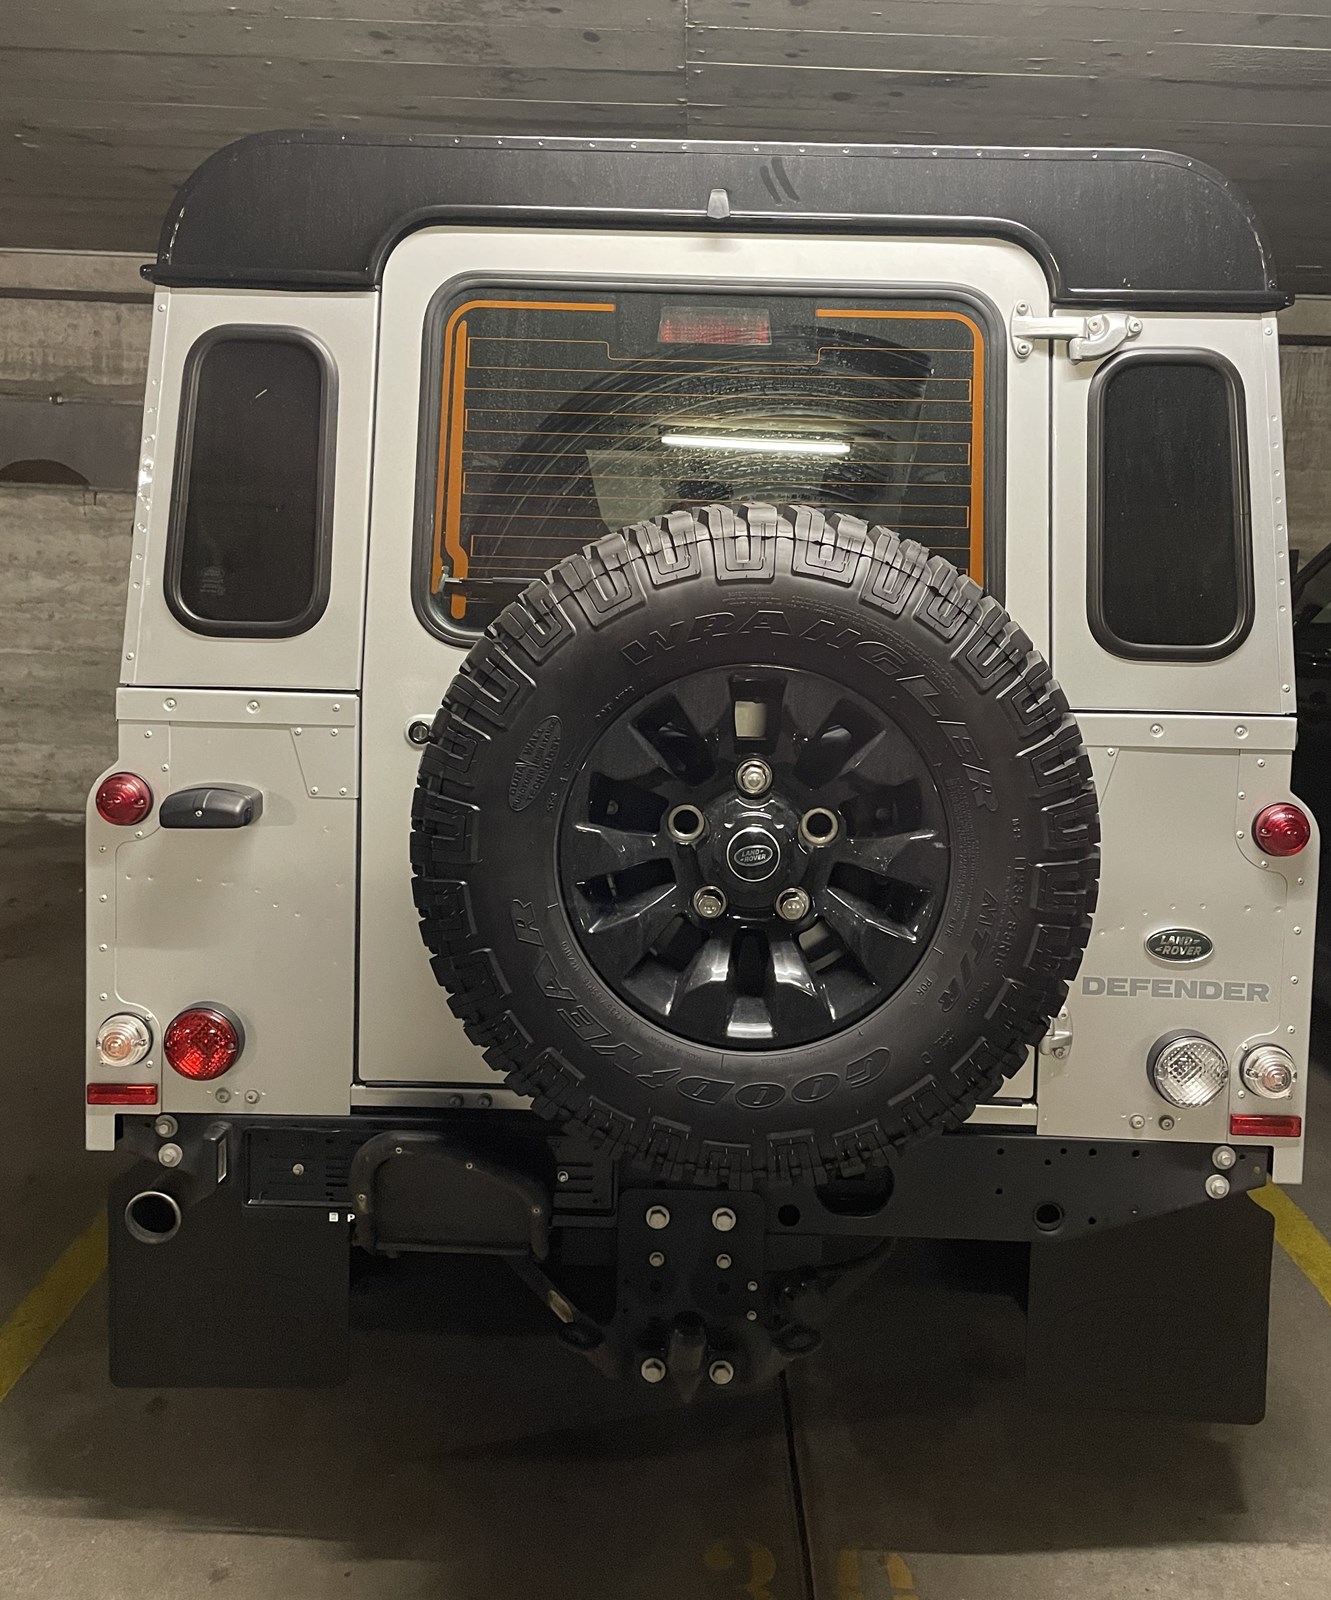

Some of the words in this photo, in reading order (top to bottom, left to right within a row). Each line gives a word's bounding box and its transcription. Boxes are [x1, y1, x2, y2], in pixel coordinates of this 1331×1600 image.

[620, 609, 999, 812] WRANGLER
[1160, 935, 1193, 945] LAND
[1162, 945, 1201, 956] ROVER
[1082, 976, 1269, 1002] DEFENDER
[510, 898, 892, 1109] GOODYEAR
